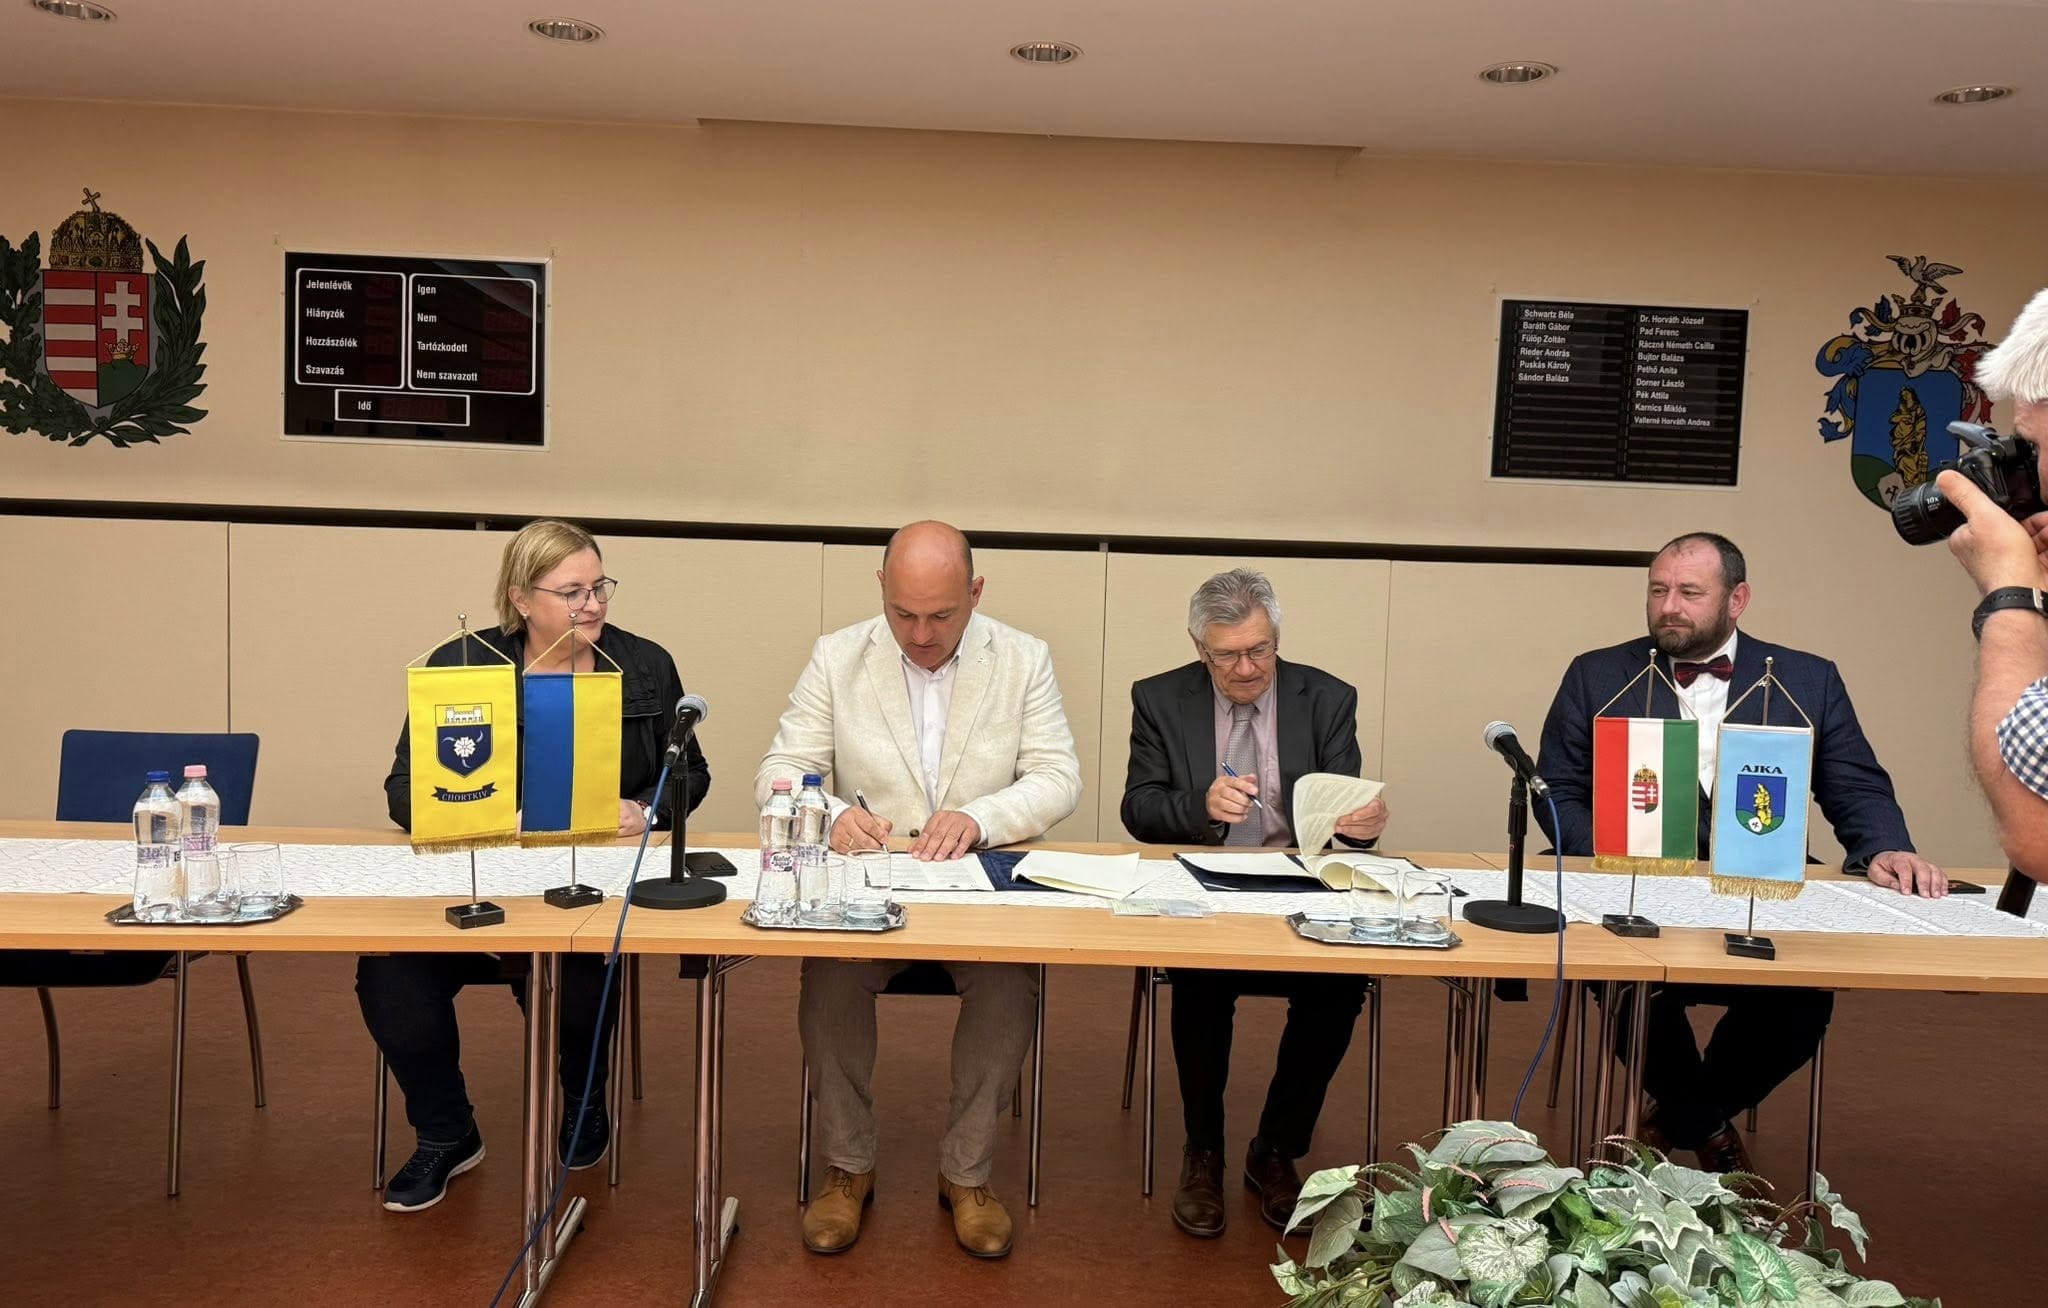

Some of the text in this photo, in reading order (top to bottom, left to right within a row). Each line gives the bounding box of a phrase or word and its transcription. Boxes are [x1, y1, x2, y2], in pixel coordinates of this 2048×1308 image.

[306, 279, 353, 291] Jelenlévők
[417, 284, 437, 296] Igen
[306, 307, 345, 320] Hiányzók
[417, 313, 437, 323] Nem
[1524, 309, 1575, 319] Schwartz Béla
[1640, 314, 1705, 325] Dr. Horváth József
[1522, 321, 1571, 331] Baráth Gábor
[1654, 327, 1680, 336] Ferenc
[305, 336, 358, 348] Hozzászólók
[1521, 334, 1566, 344] Fülöp Zoltán
[416, 340, 468, 353] Tartózkodott
[1638, 340, 1715, 350] Ráczné Németh Csilla
[1520, 347, 1571, 358] Rieder András
[1637, 352, 1685, 362] Bujtor Balázs
[305, 364, 345, 375] Szavazás
[1519, 360, 1571, 371] Puskás Károly
[1658, 366, 1678, 374] Anita
[416, 369, 478, 382] Nem szavazott
[1518, 373, 1570, 383] Sándor Balázs
[1661, 379, 1685, 388] László
[1650, 391, 1670, 400] Attila
[357, 400, 373, 411] Idő
[1663, 404, 1687, 413] Miklós
[1661, 417, 1686, 425] Horváth
[1687, 418, 1711, 426] Andrea
[1741, 764, 1783, 774] AJKA
[442, 790, 488, 800] CHORTKIV
